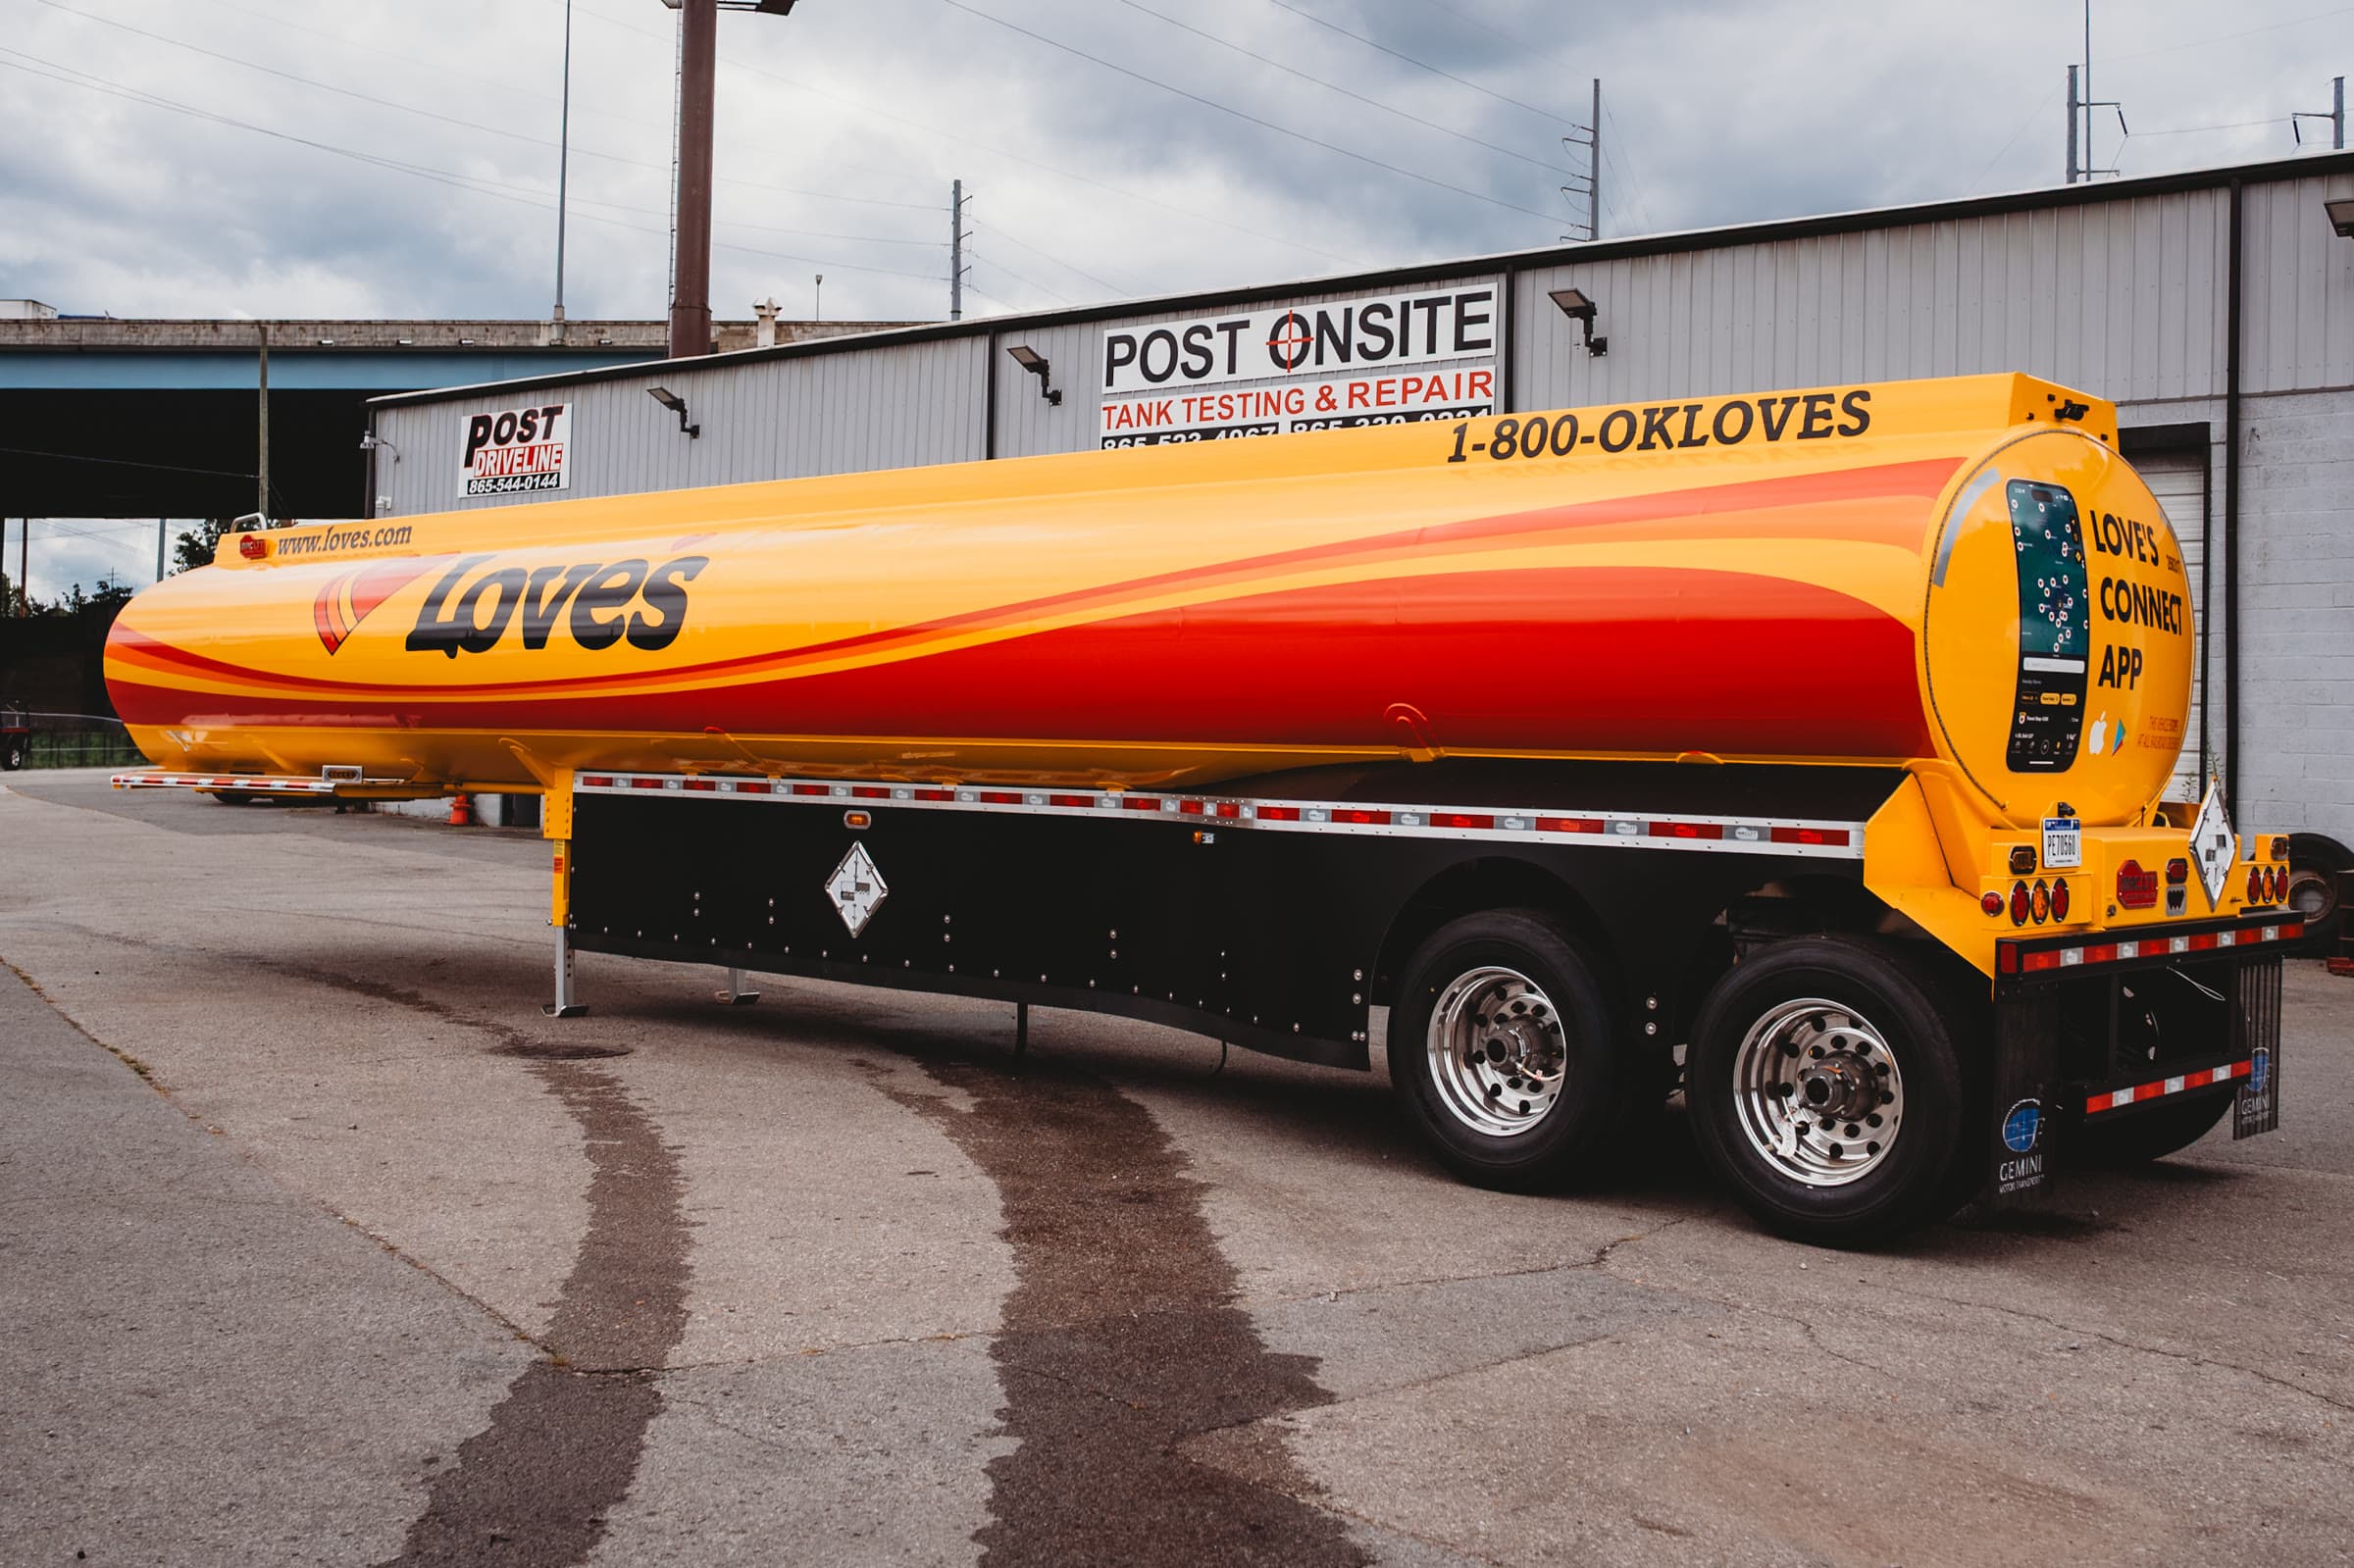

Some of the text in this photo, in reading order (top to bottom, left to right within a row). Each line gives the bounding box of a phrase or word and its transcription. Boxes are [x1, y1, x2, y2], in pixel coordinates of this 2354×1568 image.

[1105, 290, 1493, 387] POST ONSITE
[1102, 371, 1493, 430] TANK TESTING & REPAIR
[1448, 390, 1871, 463] 1-800-OKLOVES
[464, 405, 564, 468] POST
[475, 443, 563, 478] DRIVELINE
[468, 473, 559, 494] 865-544-0144
[278, 525, 413, 556] www.loves.com
[2089, 509, 2160, 567] LOVE'S
[2100, 576, 2182, 636] CONNECT
[2096, 643, 2143, 690] APP
[1999, 1153, 2043, 1182] GEMINI
